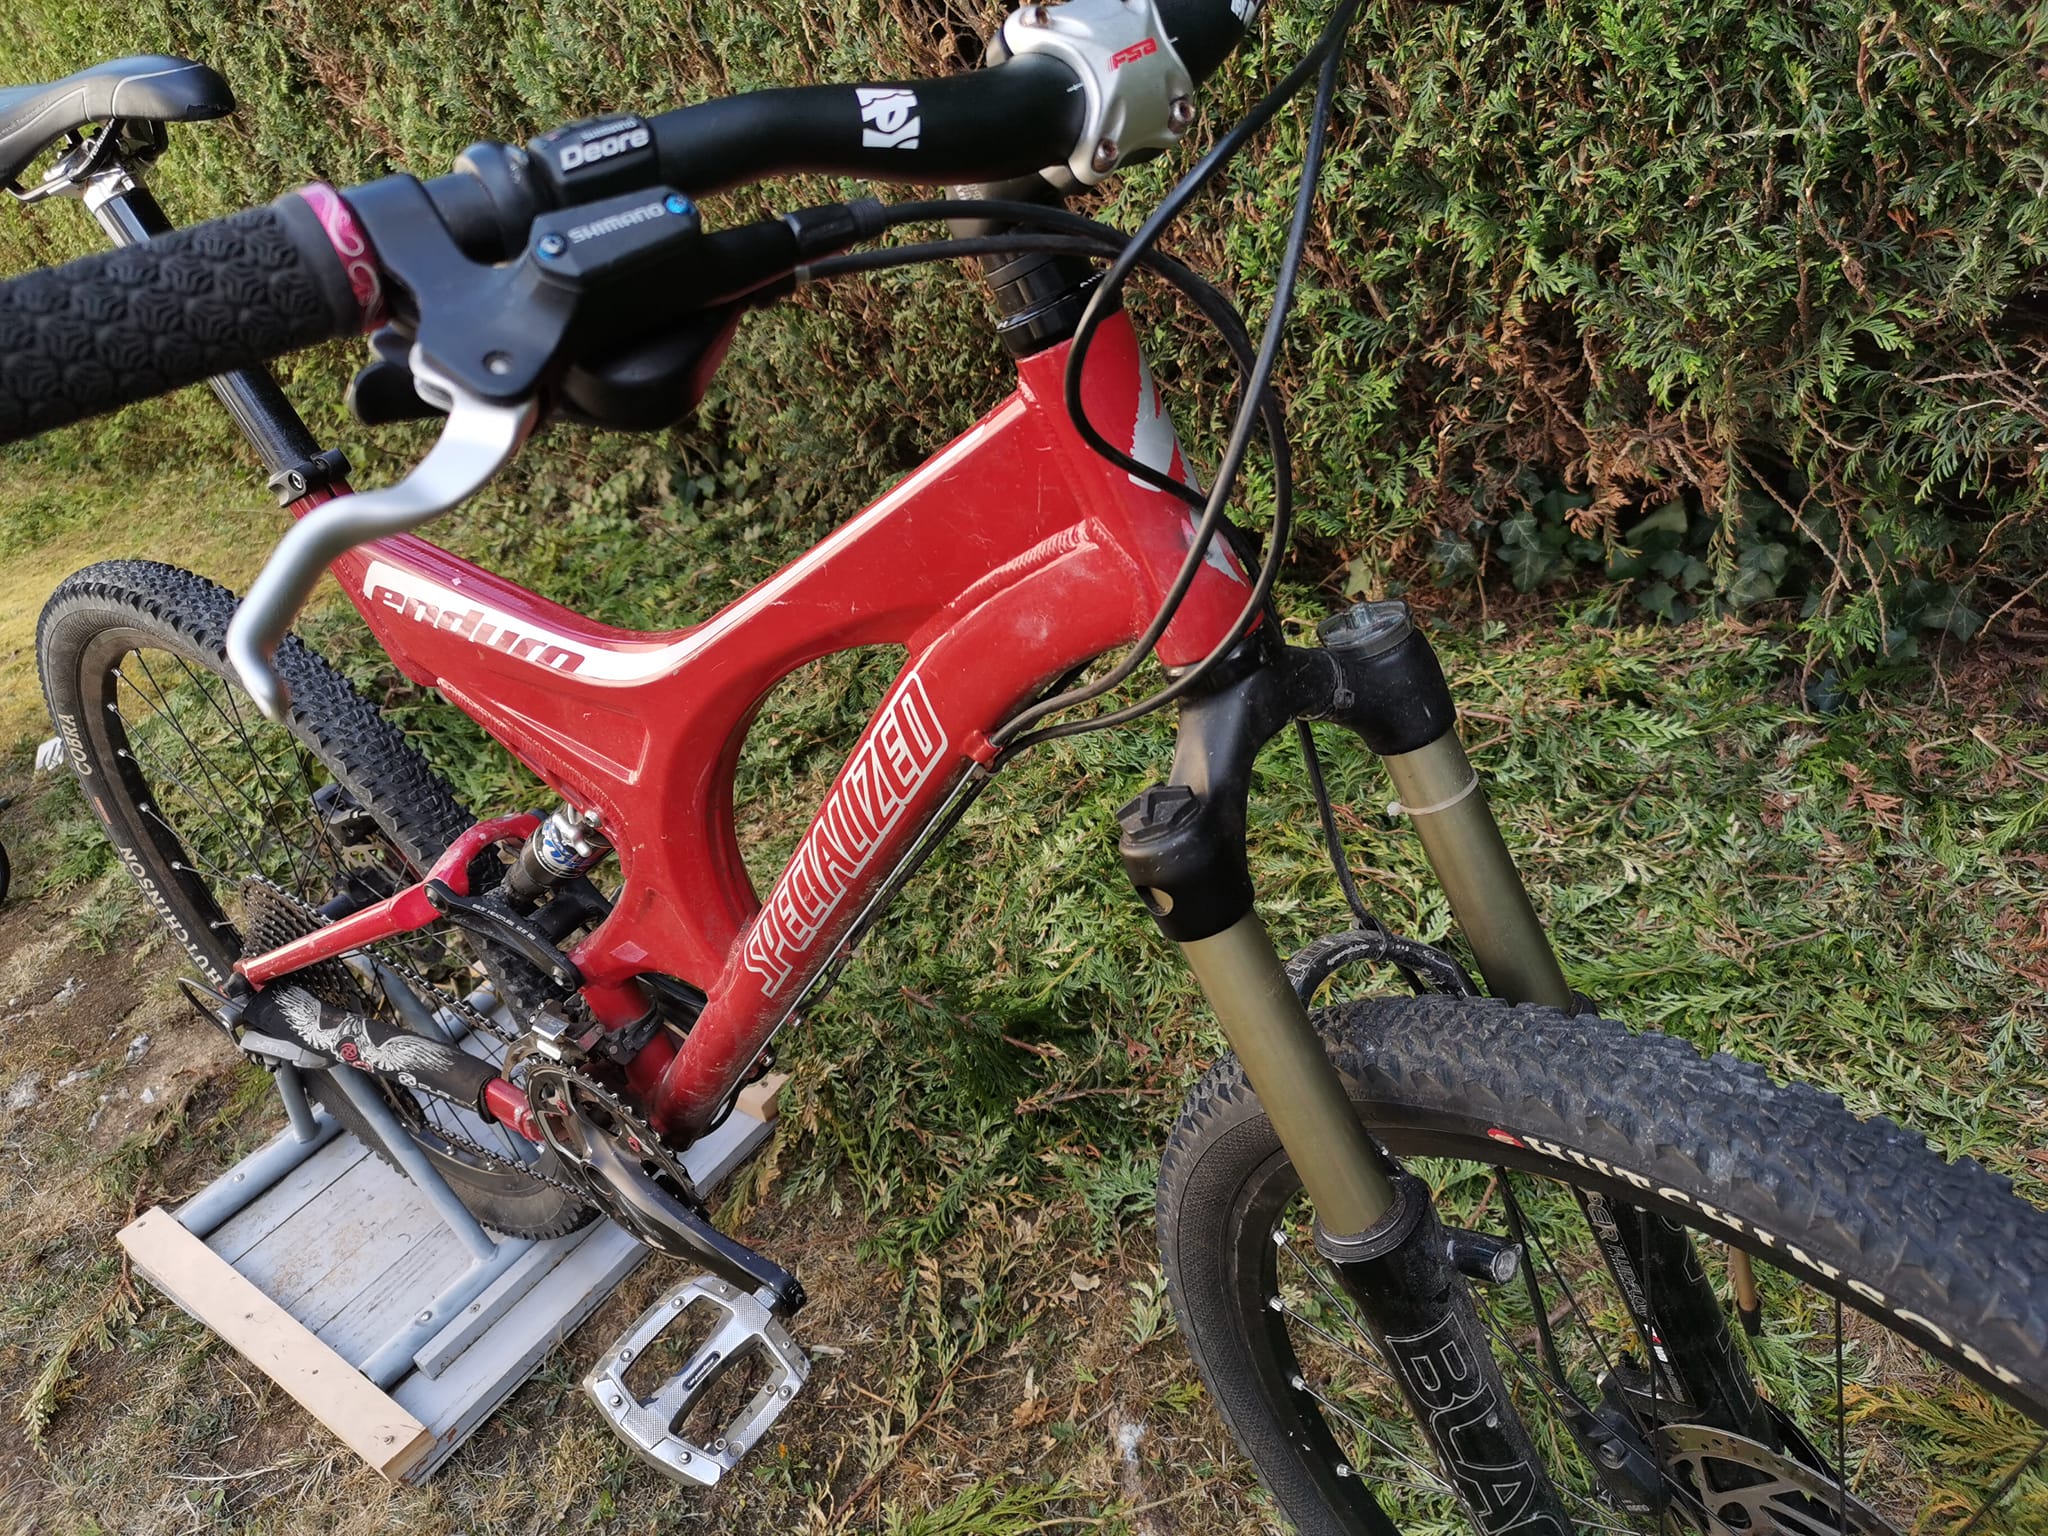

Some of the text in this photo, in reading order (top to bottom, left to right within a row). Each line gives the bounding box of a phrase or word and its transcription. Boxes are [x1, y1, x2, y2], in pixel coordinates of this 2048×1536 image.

[560, 128, 650, 171] Deore
[567, 202, 666, 244] SHIMANO
[372, 584, 586, 673] enduro
[58, 713, 93, 776] COBRA
[744, 670, 949, 998] SPECIALIZED
[119, 847, 224, 985] HUTCHINSON
[1385, 1311, 1574, 1536] BLA
